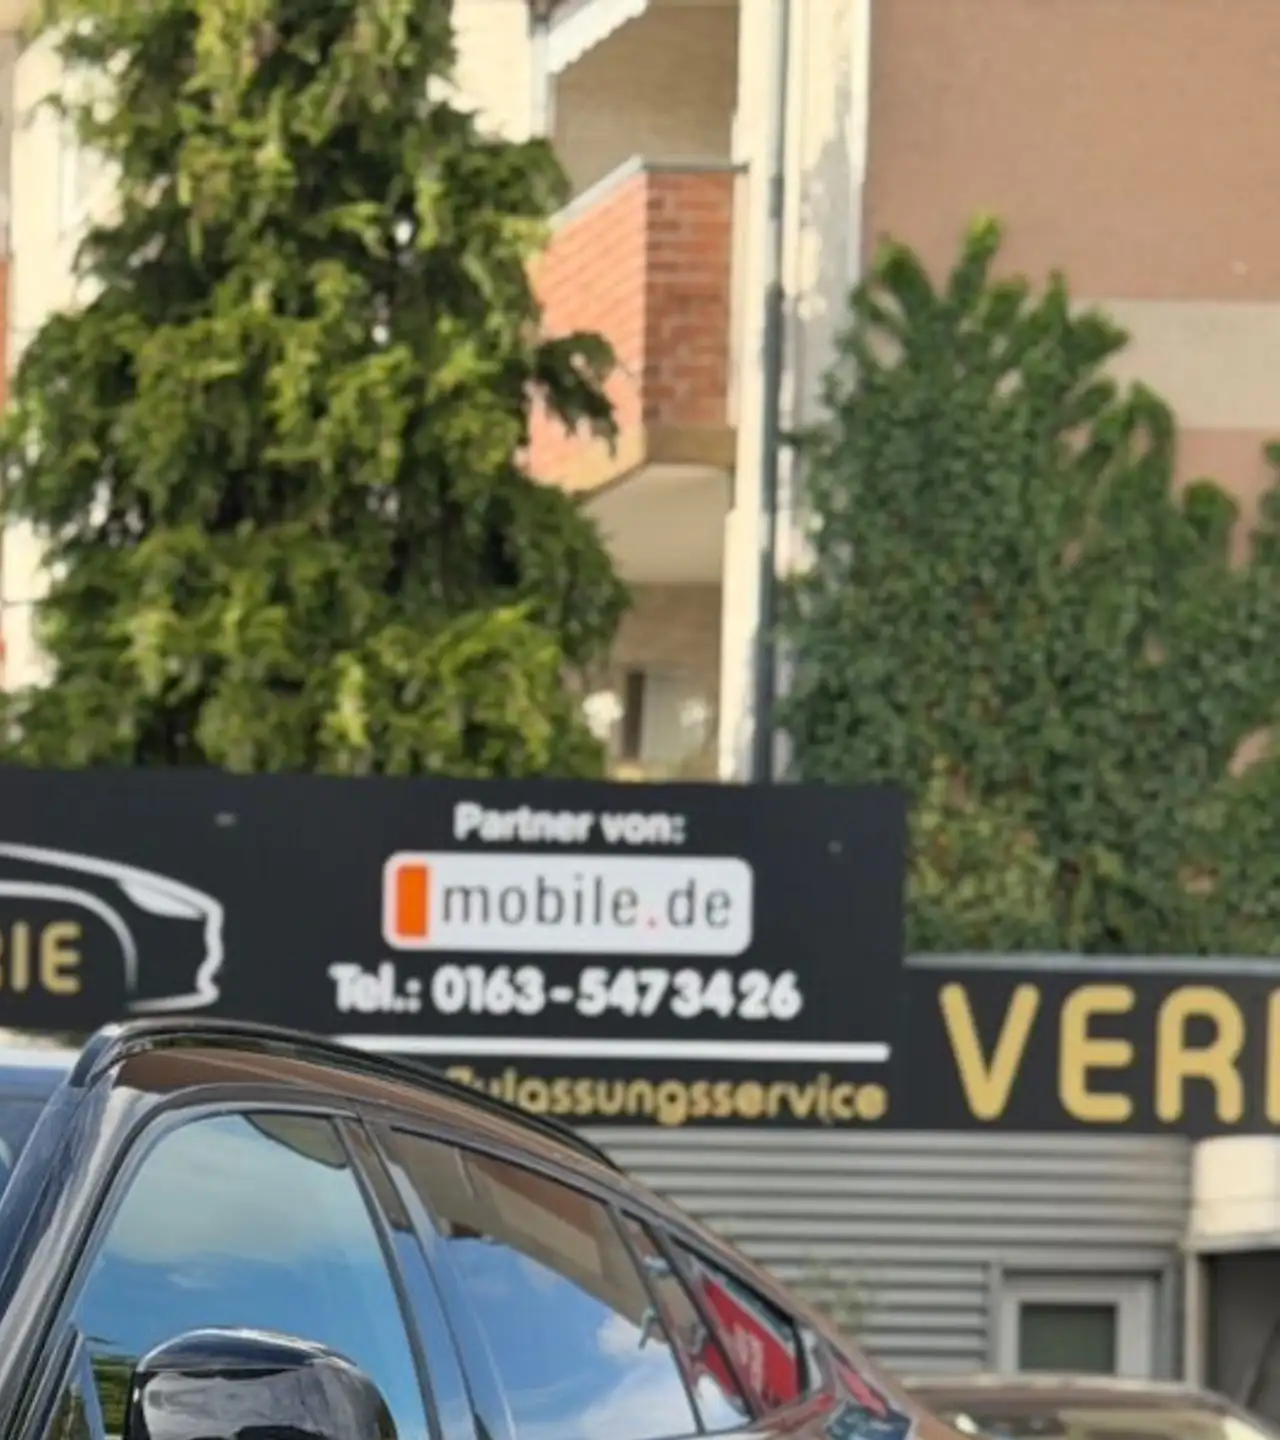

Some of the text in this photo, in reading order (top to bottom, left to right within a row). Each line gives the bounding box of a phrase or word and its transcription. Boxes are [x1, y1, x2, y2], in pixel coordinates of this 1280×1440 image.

[453, 801, 685, 845] Partner von:
[442, 873, 733, 929] mobile.de
[328, 961, 803, 1020] Tel.: 0163-5473426
[938, 981, 1280, 1125] VER
